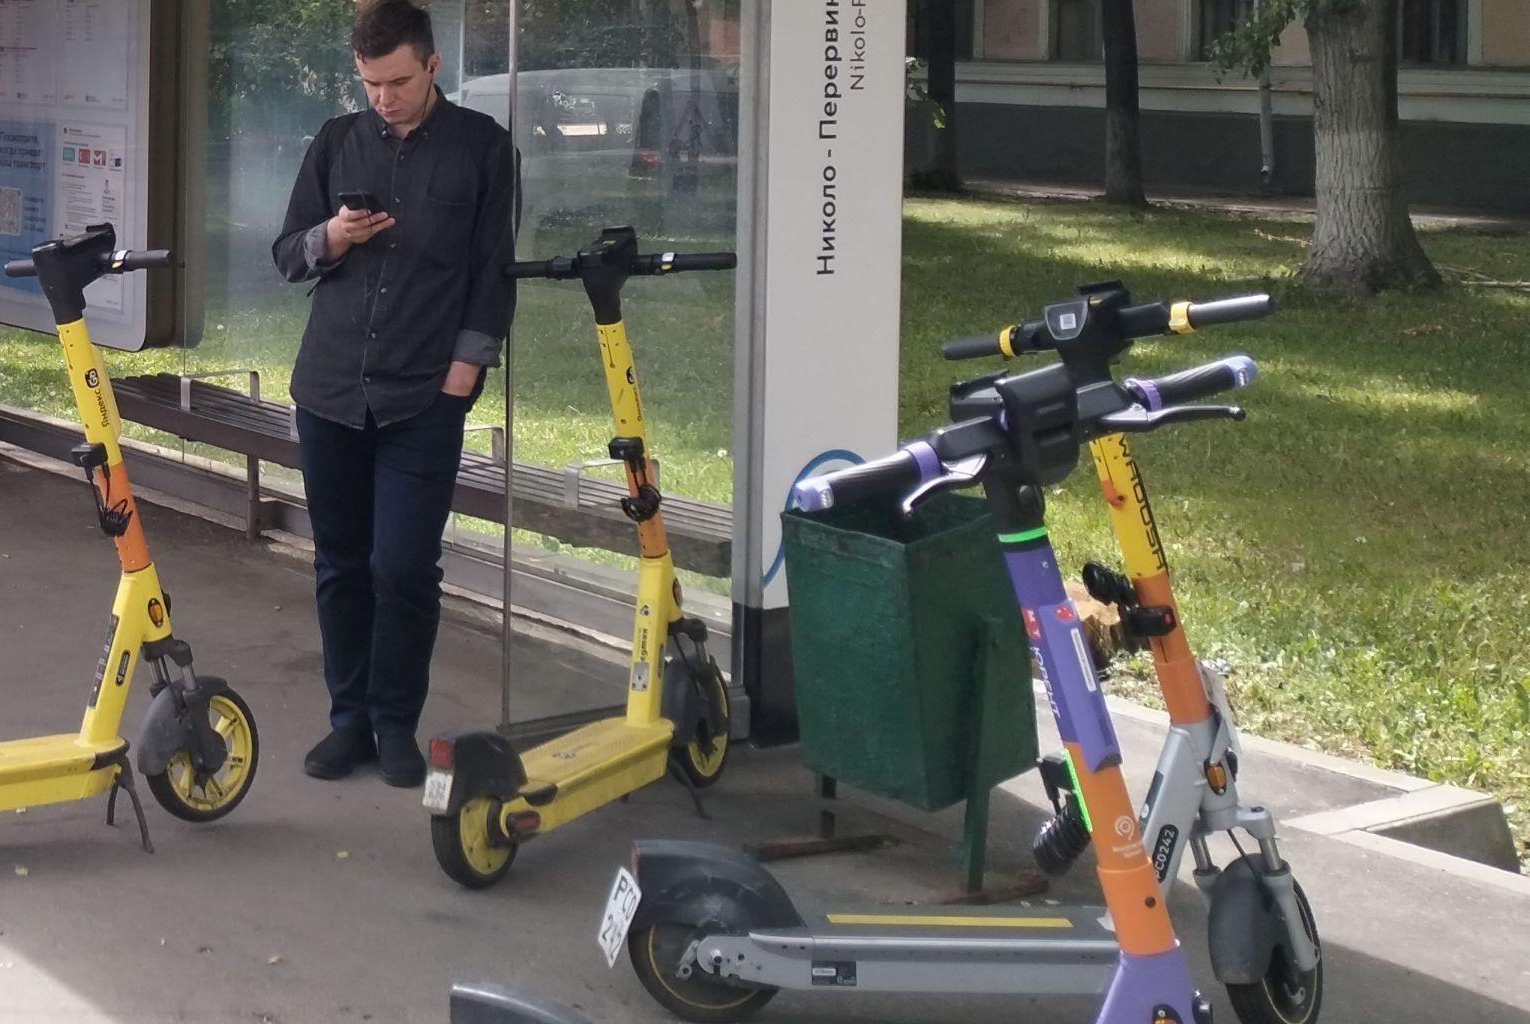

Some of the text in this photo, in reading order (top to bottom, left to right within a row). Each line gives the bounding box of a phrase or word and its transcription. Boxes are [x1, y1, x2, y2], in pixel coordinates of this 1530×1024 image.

[817, 165, 837, 275] Николо
[86, 369, 99, 387] Go
[95, 388, 110, 428] Яндекс
[601, 914, 622, 960] 242
